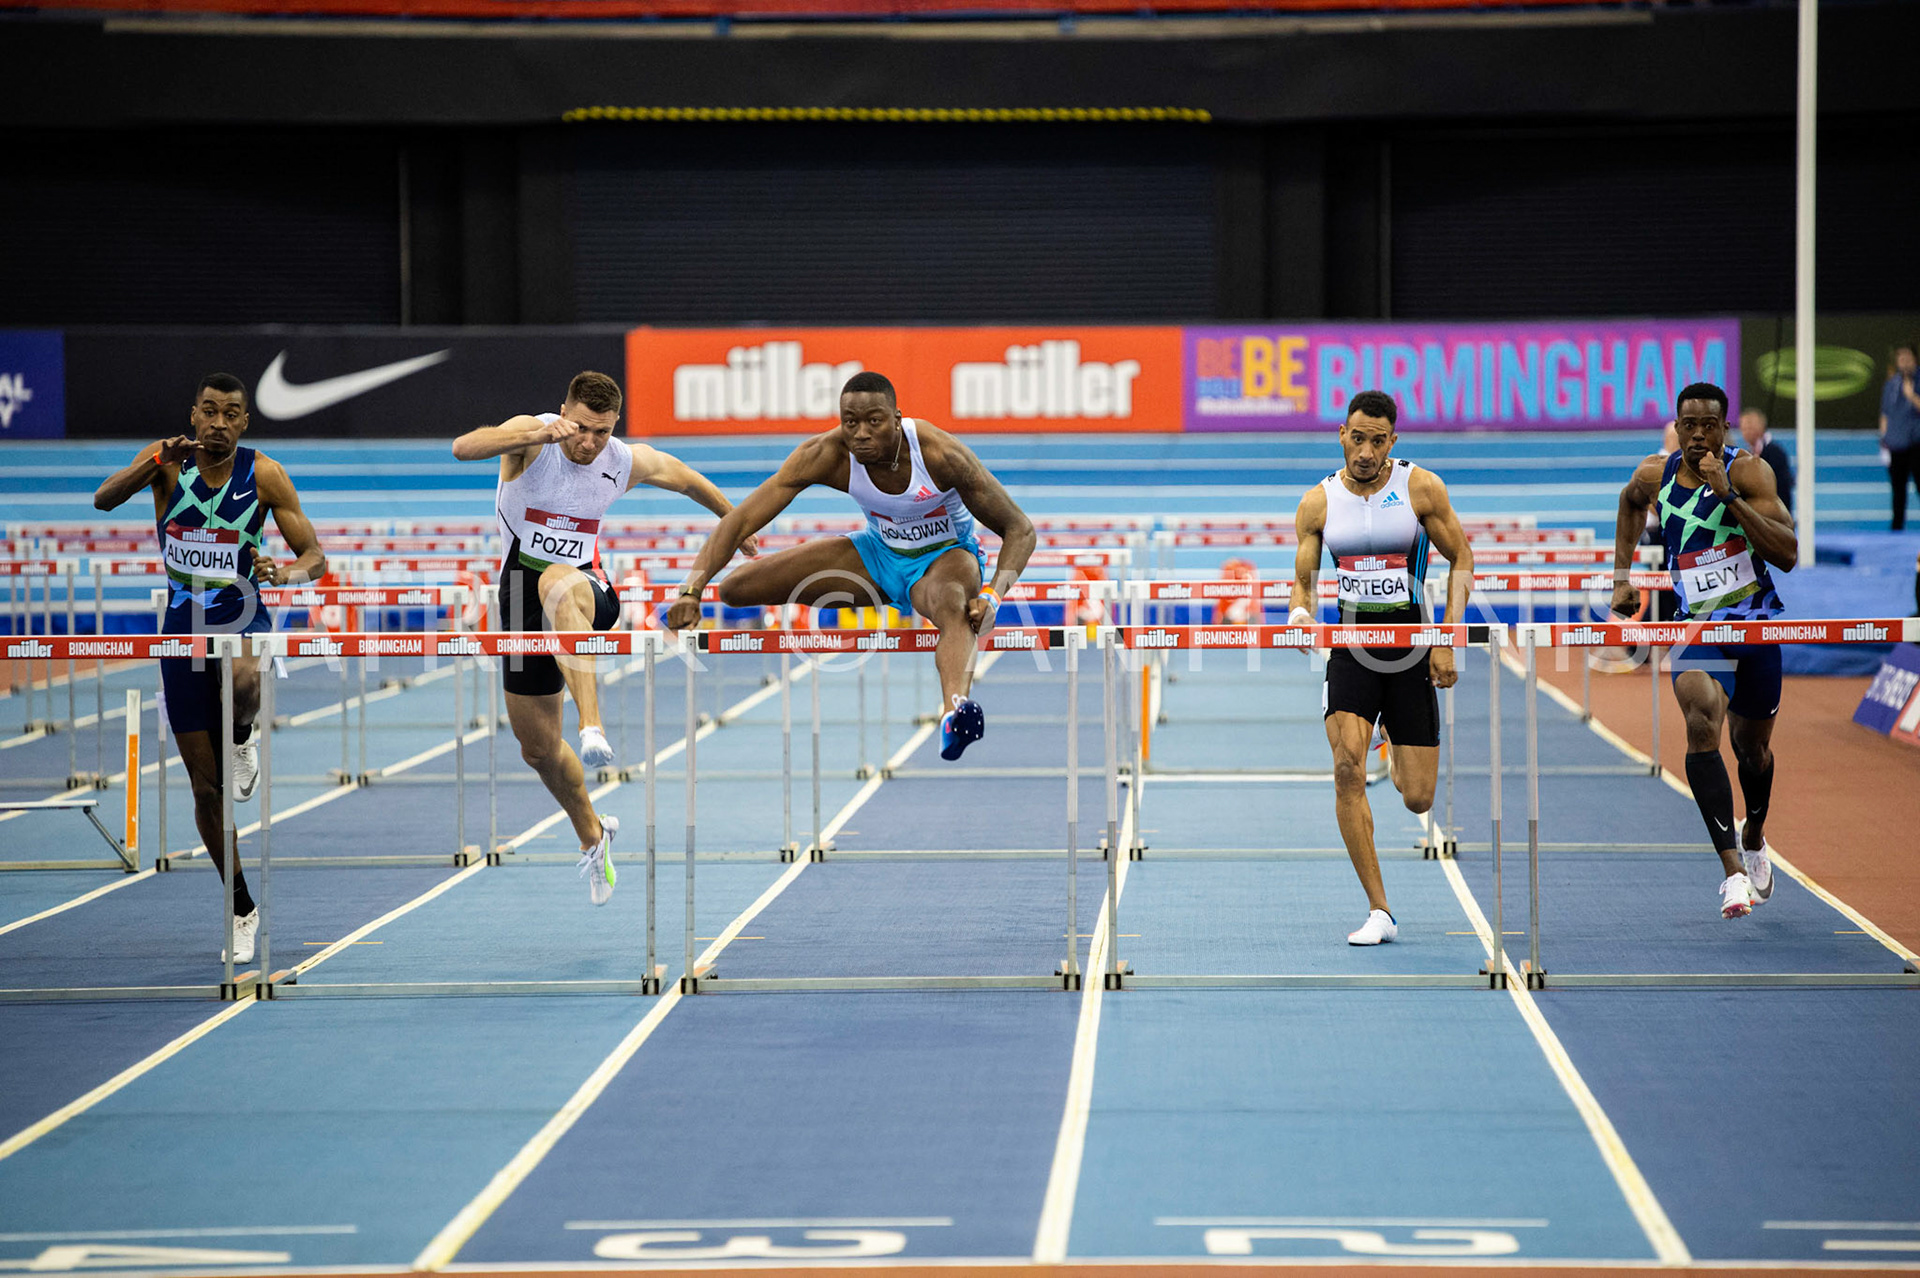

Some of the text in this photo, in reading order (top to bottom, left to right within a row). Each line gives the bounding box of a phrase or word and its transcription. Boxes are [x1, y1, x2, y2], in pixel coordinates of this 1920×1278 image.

[951, 339, 1141, 419] müller
[1242, 335, 1727, 421] BE BIRMINGHAM
[546, 516, 580, 531] müller
[880, 519, 950, 542] HOLLOWAY
[182, 528, 218, 543] müller
[531, 531, 584, 560] POZZI
[167, 543, 235, 570] ALYOUHA
[1354, 556, 1388, 571] müller
[1694, 548, 1727, 566] müller
[1342, 576, 1406, 597] ORTEGA
[1519, 577, 1570, 590] BIRMINGHAM
[1694, 563, 1739, 593] LEVY
[337, 592, 386, 604] BIRMINGHAM
[1203, 584, 1253, 597] BIRMINGHAM
[720, 633, 764, 651] müller
[779, 634, 842, 649] BIRMINGHAM
[857, 632, 901, 650] müller
[993, 630, 1037, 648] müller
[1136, 628, 1455, 648] müller BIRMINGHAM müller BIRMINGHAM müller
[1562, 623, 1889, 645] müller BIRMINGHAM müller BIRMINGHAM müller
[7, 639, 193, 658] müller BIRMINGHAM müller
[299, 636, 619, 655] müller BIRMINGHAM müller BIRMINGHAM müller
